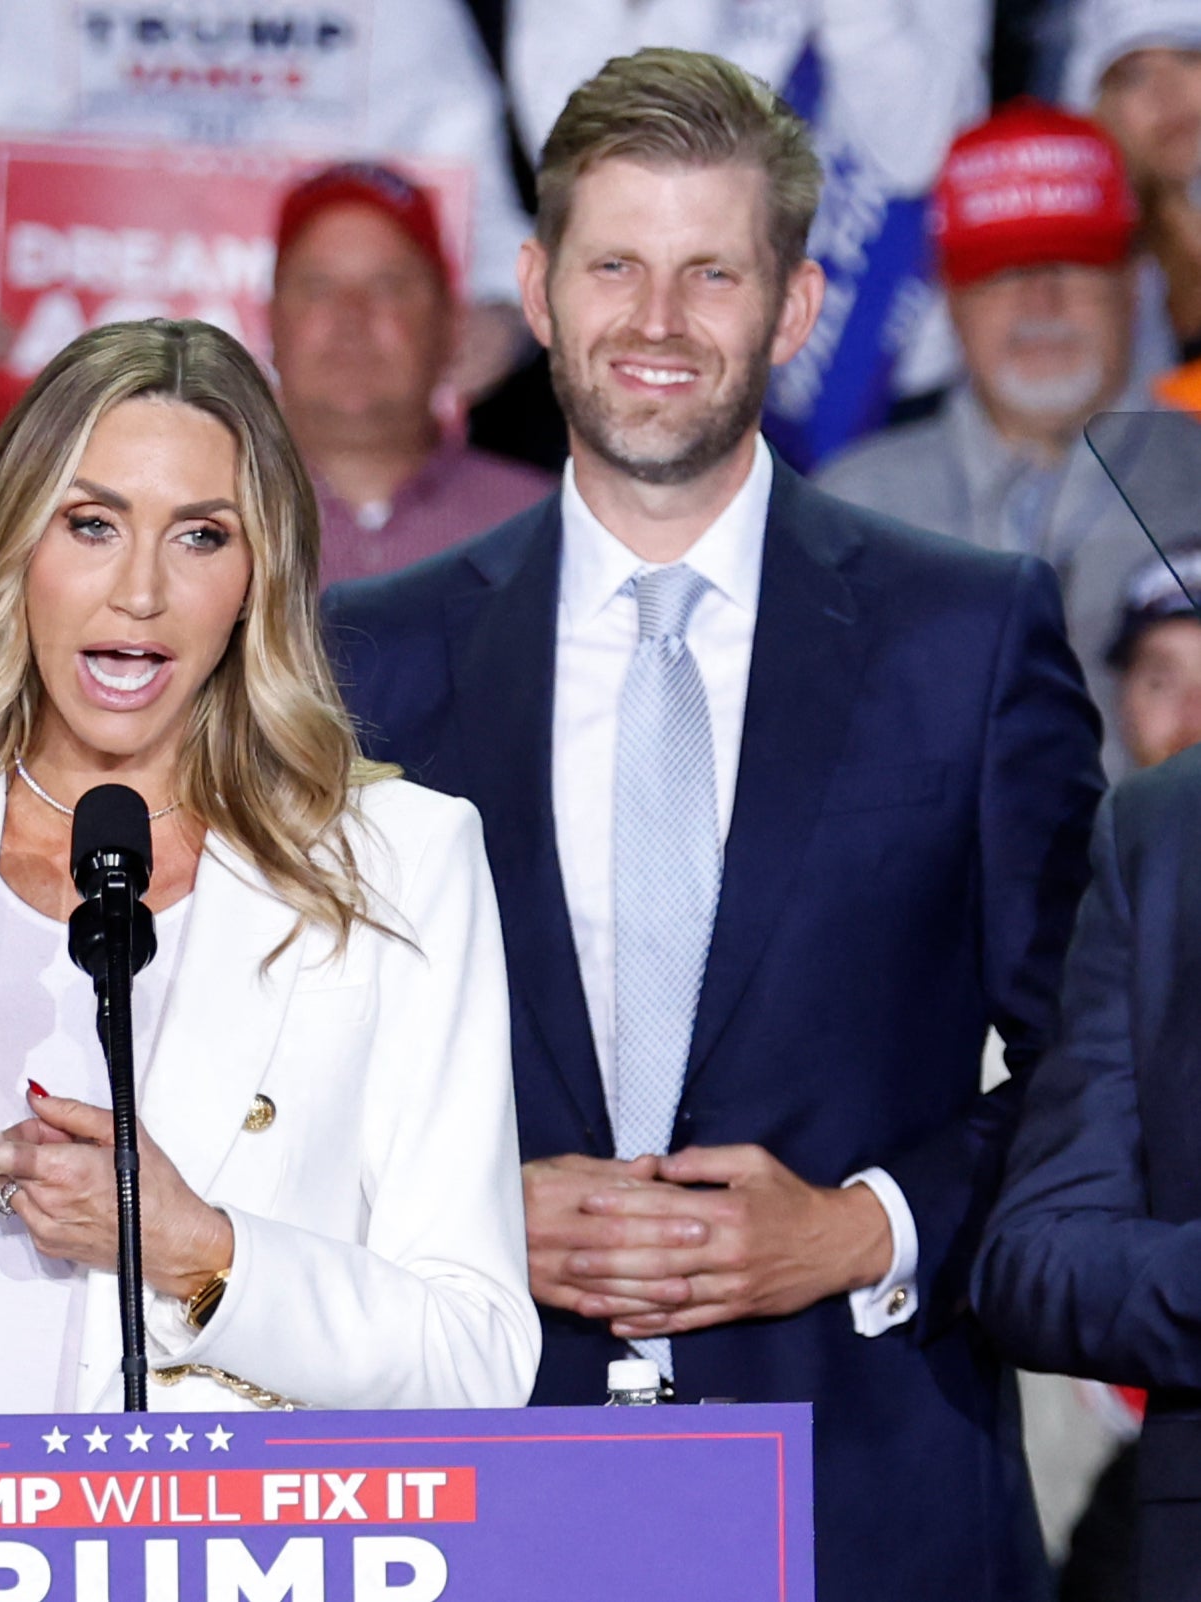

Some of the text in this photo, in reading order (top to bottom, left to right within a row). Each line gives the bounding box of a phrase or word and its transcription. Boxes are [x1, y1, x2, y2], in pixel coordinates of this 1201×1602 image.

[79, 1474, 241, 1524] WILL
[262, 1472, 369, 1521] FIX
[387, 1471, 447, 1519] IT
